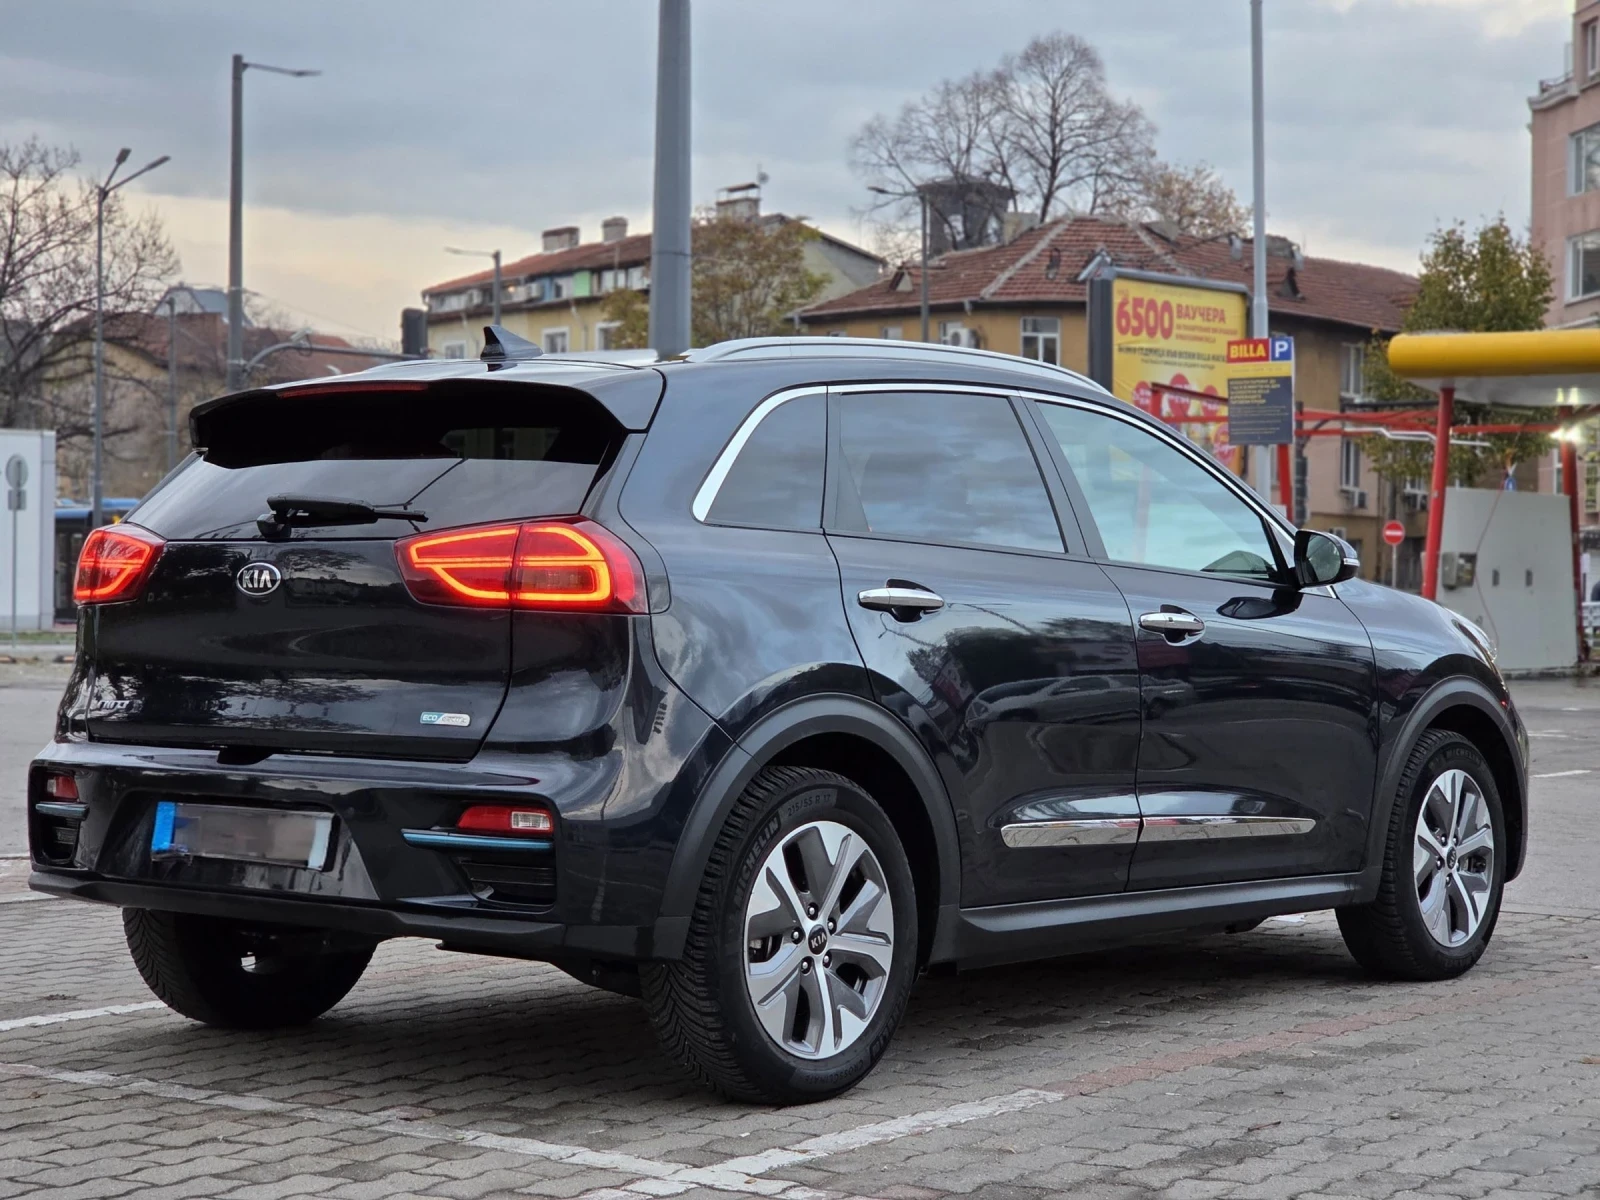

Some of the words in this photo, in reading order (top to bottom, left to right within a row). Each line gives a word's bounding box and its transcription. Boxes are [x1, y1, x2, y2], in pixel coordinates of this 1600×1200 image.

[1116, 297, 1174, 340] 6500
[1176, 303, 1226, 324] ВАУЧЕРА
[1230, 344, 1266, 358] BILLA
[1275, 341, 1288, 358] P
[243, 569, 272, 588] KIA
[1446, 748, 1481, 766] MICHELIN
[787, 796, 813, 817] 215/55
[734, 816, 780, 907] MICHELIN
[811, 932, 827, 948] KIA
